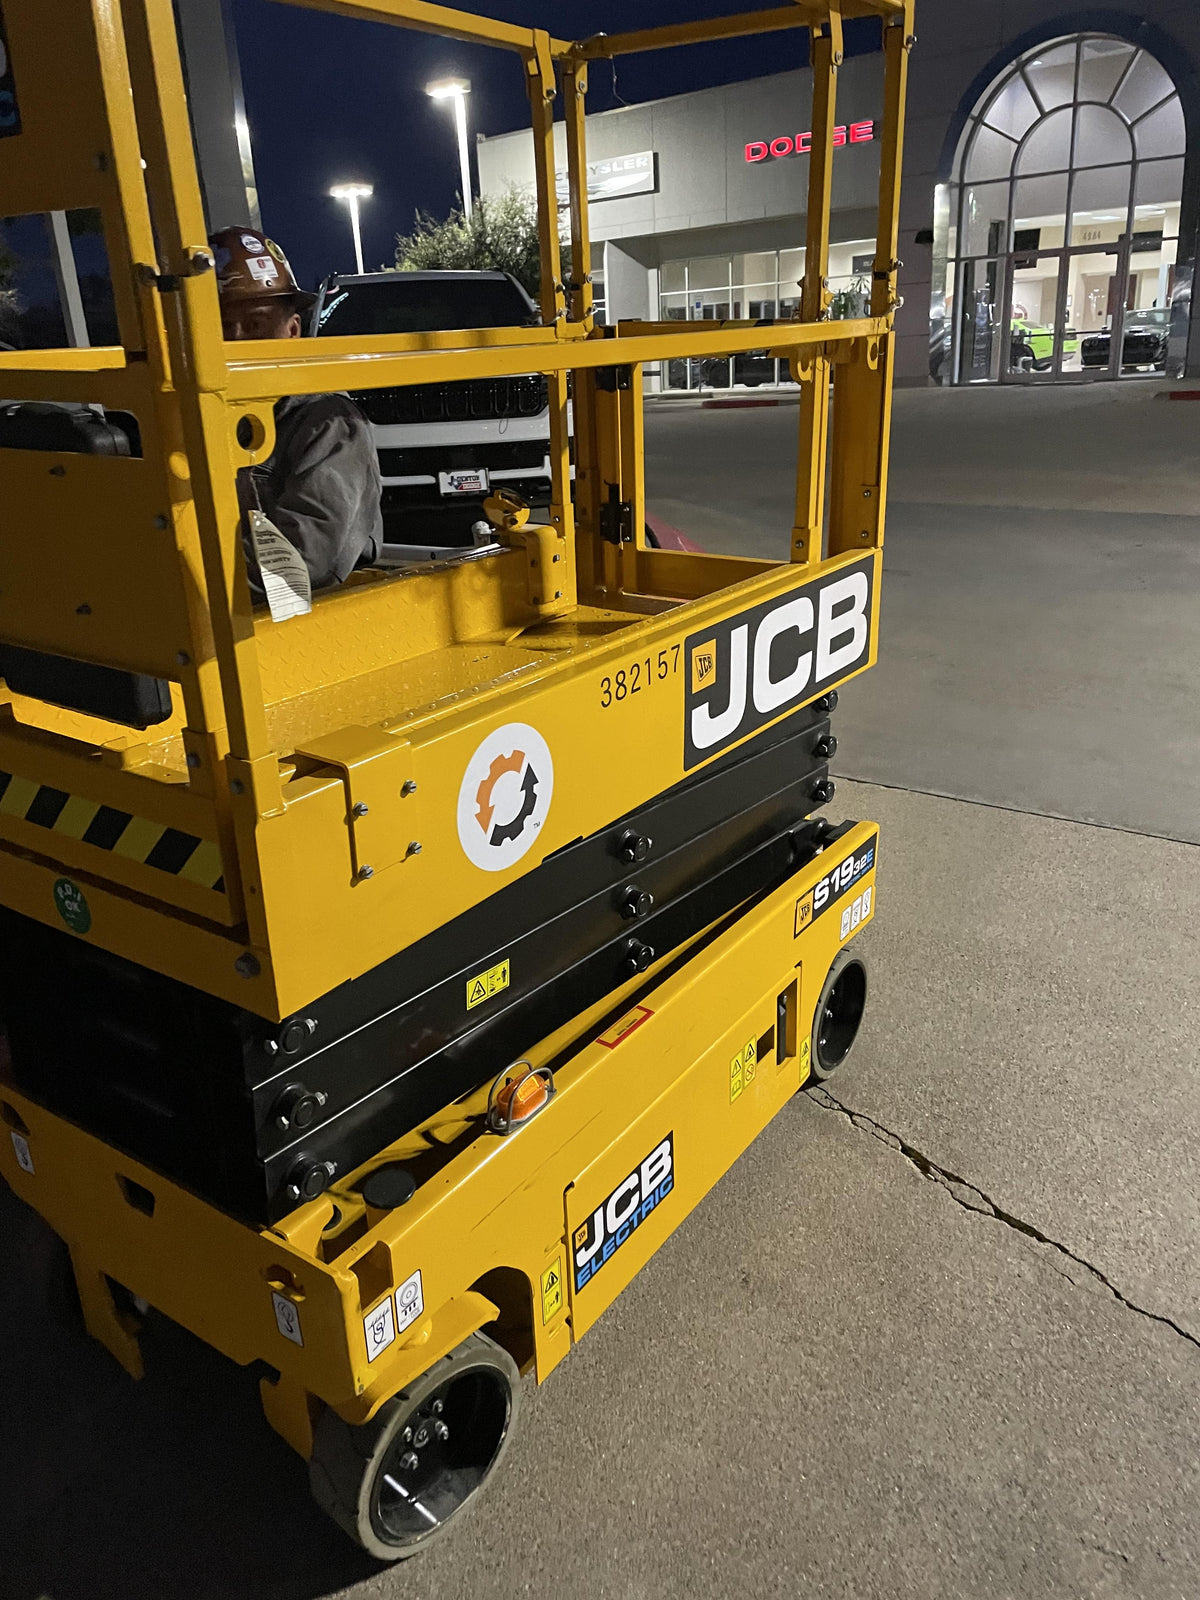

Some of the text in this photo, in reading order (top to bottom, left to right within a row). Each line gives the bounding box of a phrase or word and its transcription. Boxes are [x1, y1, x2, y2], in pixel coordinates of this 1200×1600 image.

[555, 157, 648, 181] CYSLER
[600, 643, 681, 709] 382157
[691, 571, 868, 749] JCB
[698, 656, 712, 679] JCB
[576, 1139, 672, 1268] JCB
[576, 1174, 673, 1290] ELECTRIC
